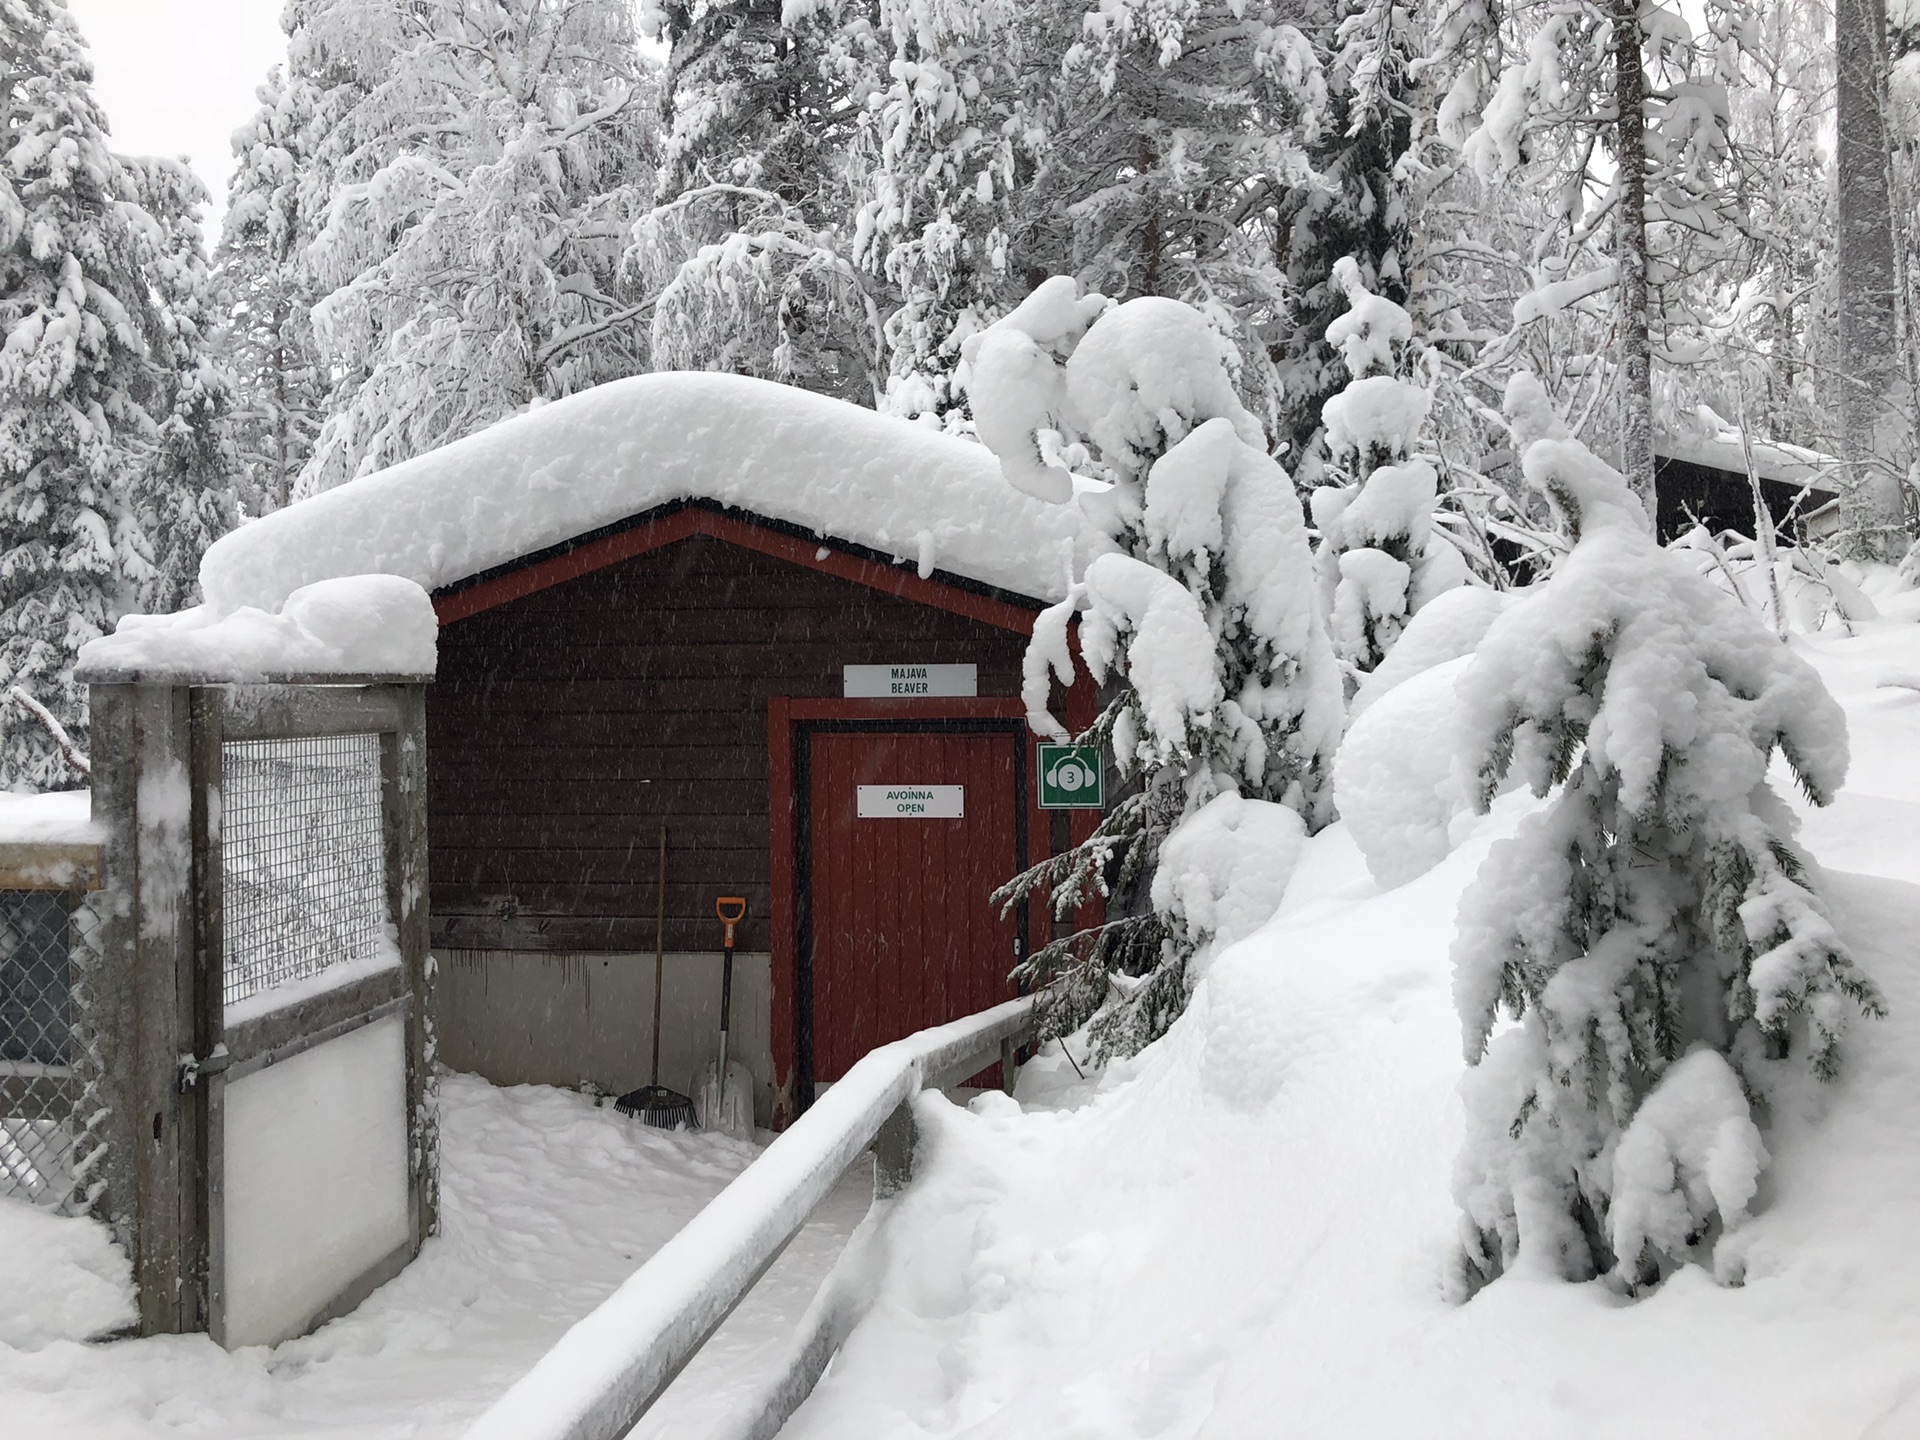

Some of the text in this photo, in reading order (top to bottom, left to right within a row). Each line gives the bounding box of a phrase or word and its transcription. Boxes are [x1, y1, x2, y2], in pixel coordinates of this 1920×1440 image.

[891, 668, 928, 679] MAJAVA
[891, 682, 929, 694] BEAVER
[1066, 771, 1075, 784] 3
[886, 790, 934, 800] AVOINNA
[896, 803, 925, 813] OPEN
